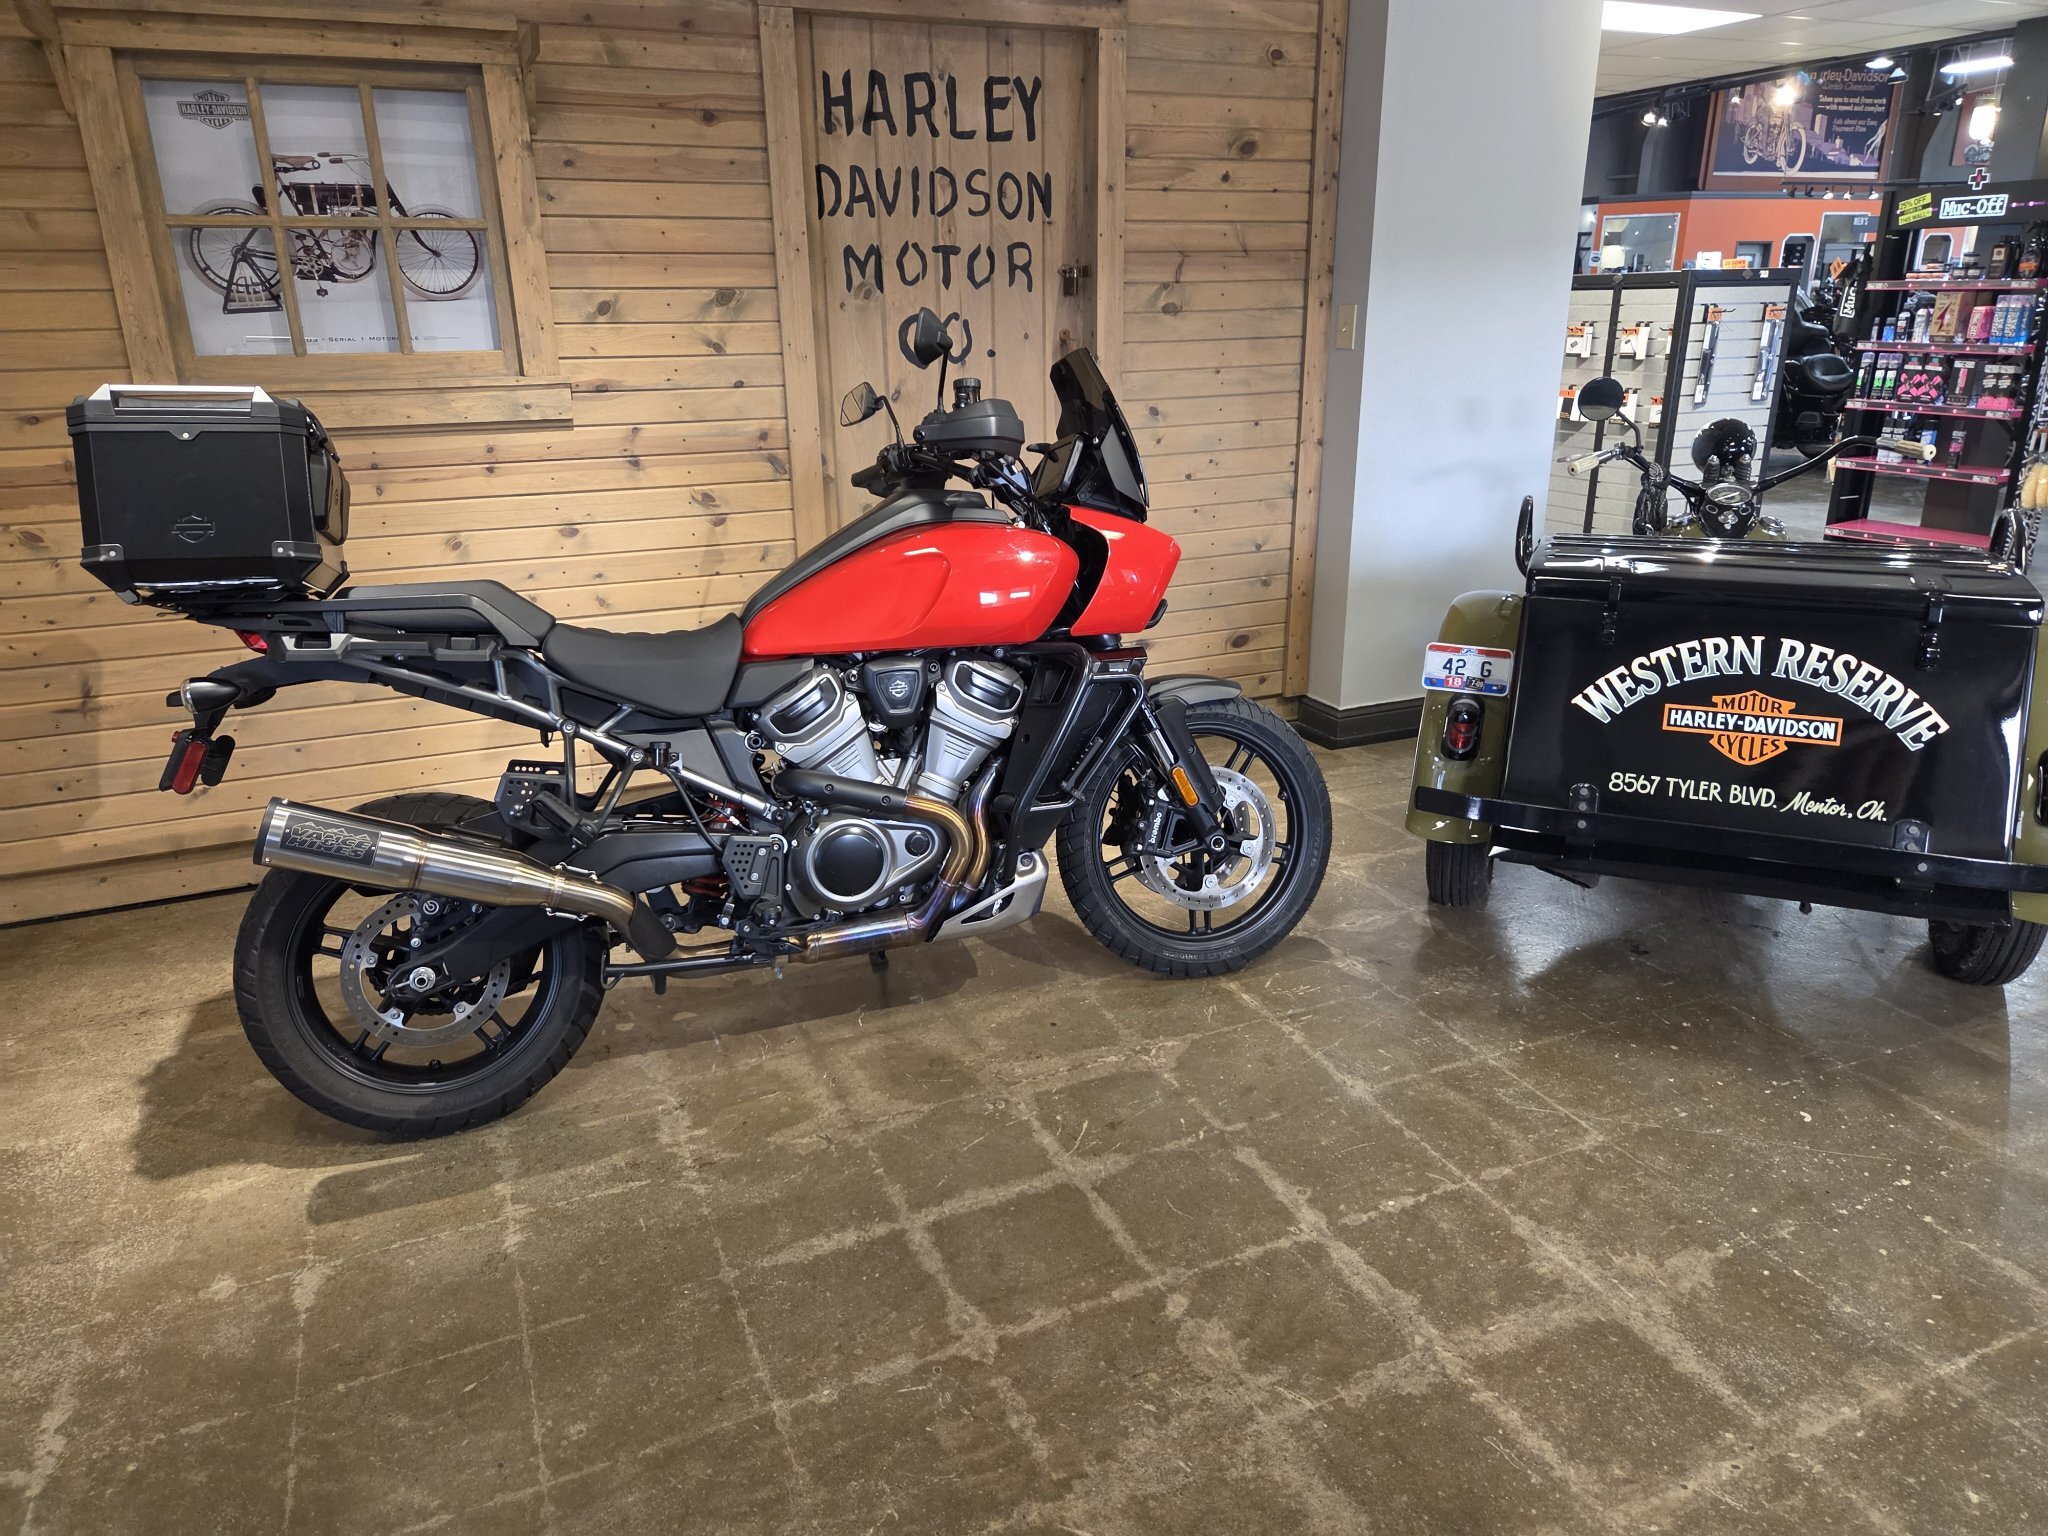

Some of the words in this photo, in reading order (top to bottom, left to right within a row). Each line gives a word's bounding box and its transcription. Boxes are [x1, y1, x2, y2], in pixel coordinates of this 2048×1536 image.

[181, 104, 248, 115] HARLEY-DAVIDSON
[197, 92, 226, 102] MOTOR
[822, 69, 1042, 142] HARLEY
[815, 164, 1052, 222] DAVIDSON
[1913, 195, 1927, 206] OFF
[1942, 197, 2004, 217] Muc-Off
[843, 240, 1033, 294] MOTOR
[898, 311, 996, 370] CO.
[1443, 658, 1467, 676] 42
[1480, 661, 1493, 678] G
[1446, 677, 1462, 686] 18
[1571, 635, 1765, 724] WESTERN
[1772, 637, 1950, 751] RESERVE
[1721, 693, 1783, 714] MOTOR
[1669, 709, 1836, 740] HARLEY-DAVIDSON
[1716, 734, 1780, 762] CYCLES
[1608, 771, 1661, 796] 8567
[1665, 777, 1723, 803] TYLER
[1729, 784, 1778, 809] BLVD.
[1779, 791, 1853, 819] Mentor,
[1856, 800, 1888, 822] Oh.
[291, 826, 373, 851] VANCE
[1148, 812, 1162, 844] brembo
[286, 836, 366, 859] HINES
